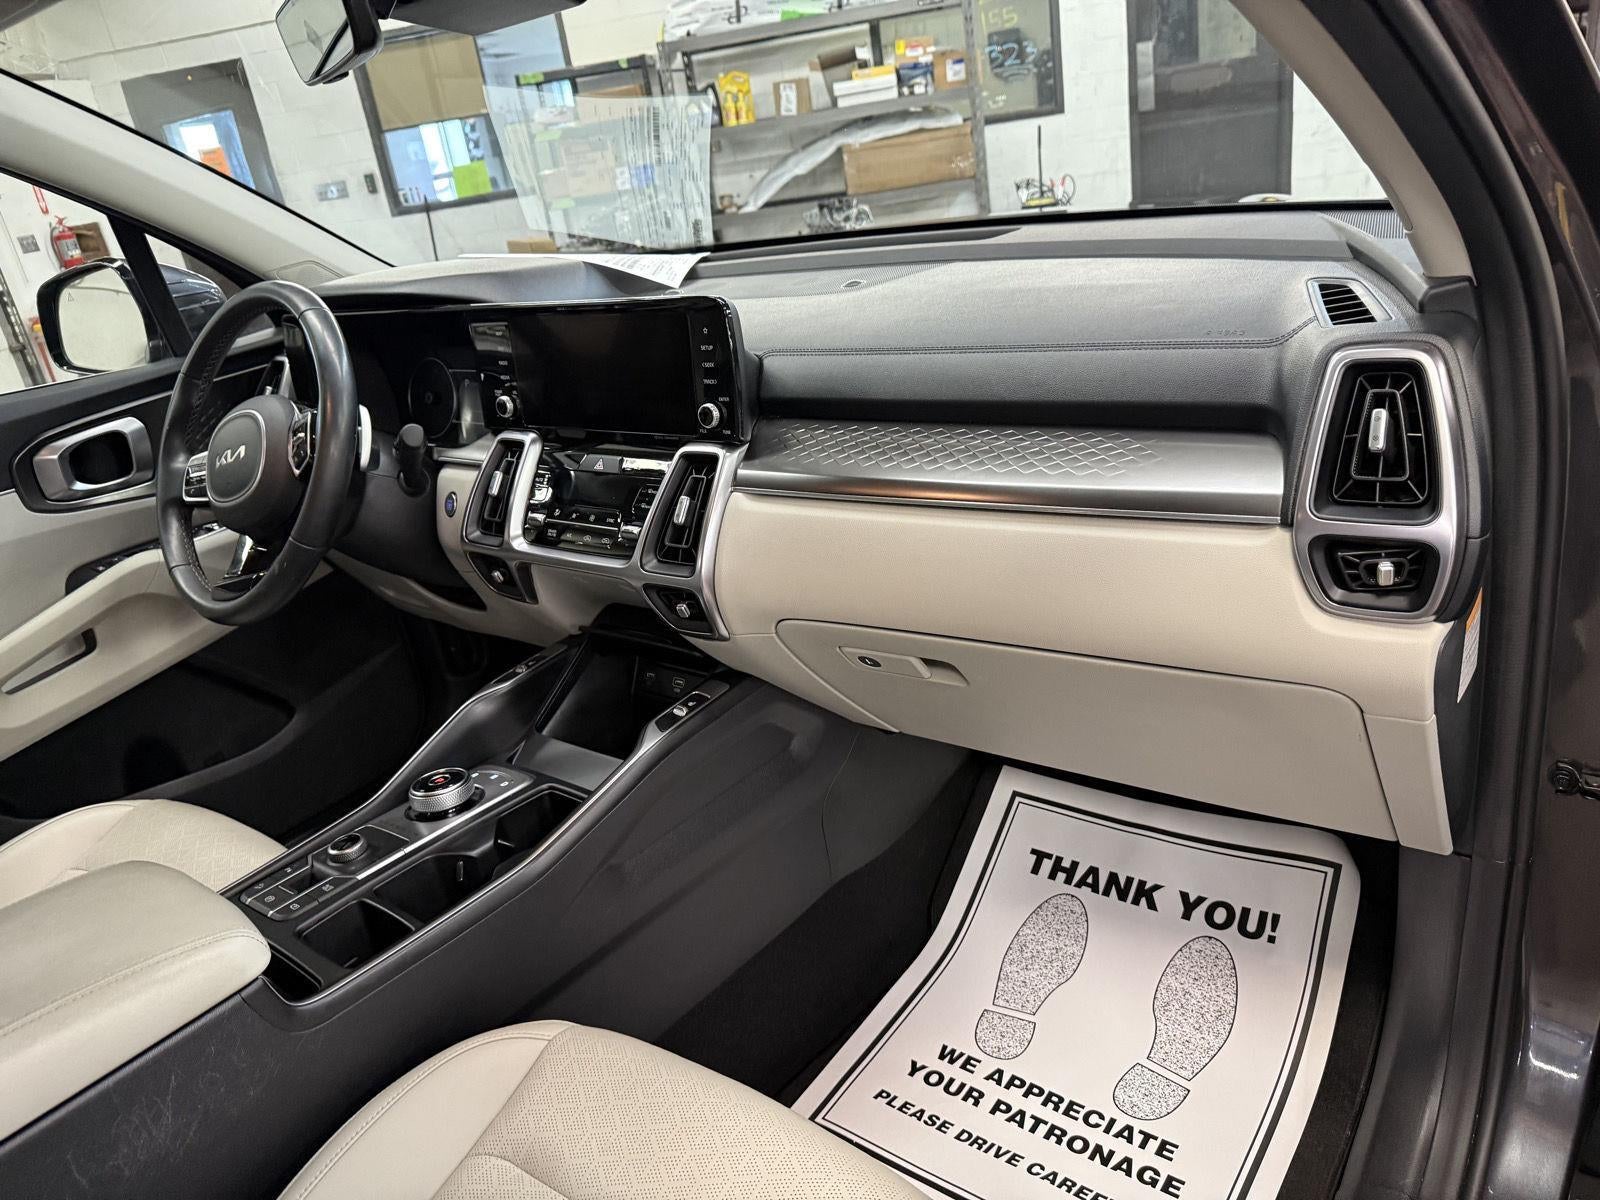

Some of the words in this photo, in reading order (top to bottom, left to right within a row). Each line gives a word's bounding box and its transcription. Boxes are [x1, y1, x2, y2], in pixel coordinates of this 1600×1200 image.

[1030, 847, 1165, 912] THANK
[1178, 890, 1281, 944] YOU!
[872, 1088, 955, 1135] PLEASE
[953, 1128, 1025, 1168] DRIVE
[1026, 1162, 1115, 1200] CAREF
[907, 1059, 986, 1108] YOUR
[988, 1098, 1186, 1199] PATRONAGE
[937, 1043, 982, 1075] WE
[983, 1067, 1180, 1162] APPRECIATE
